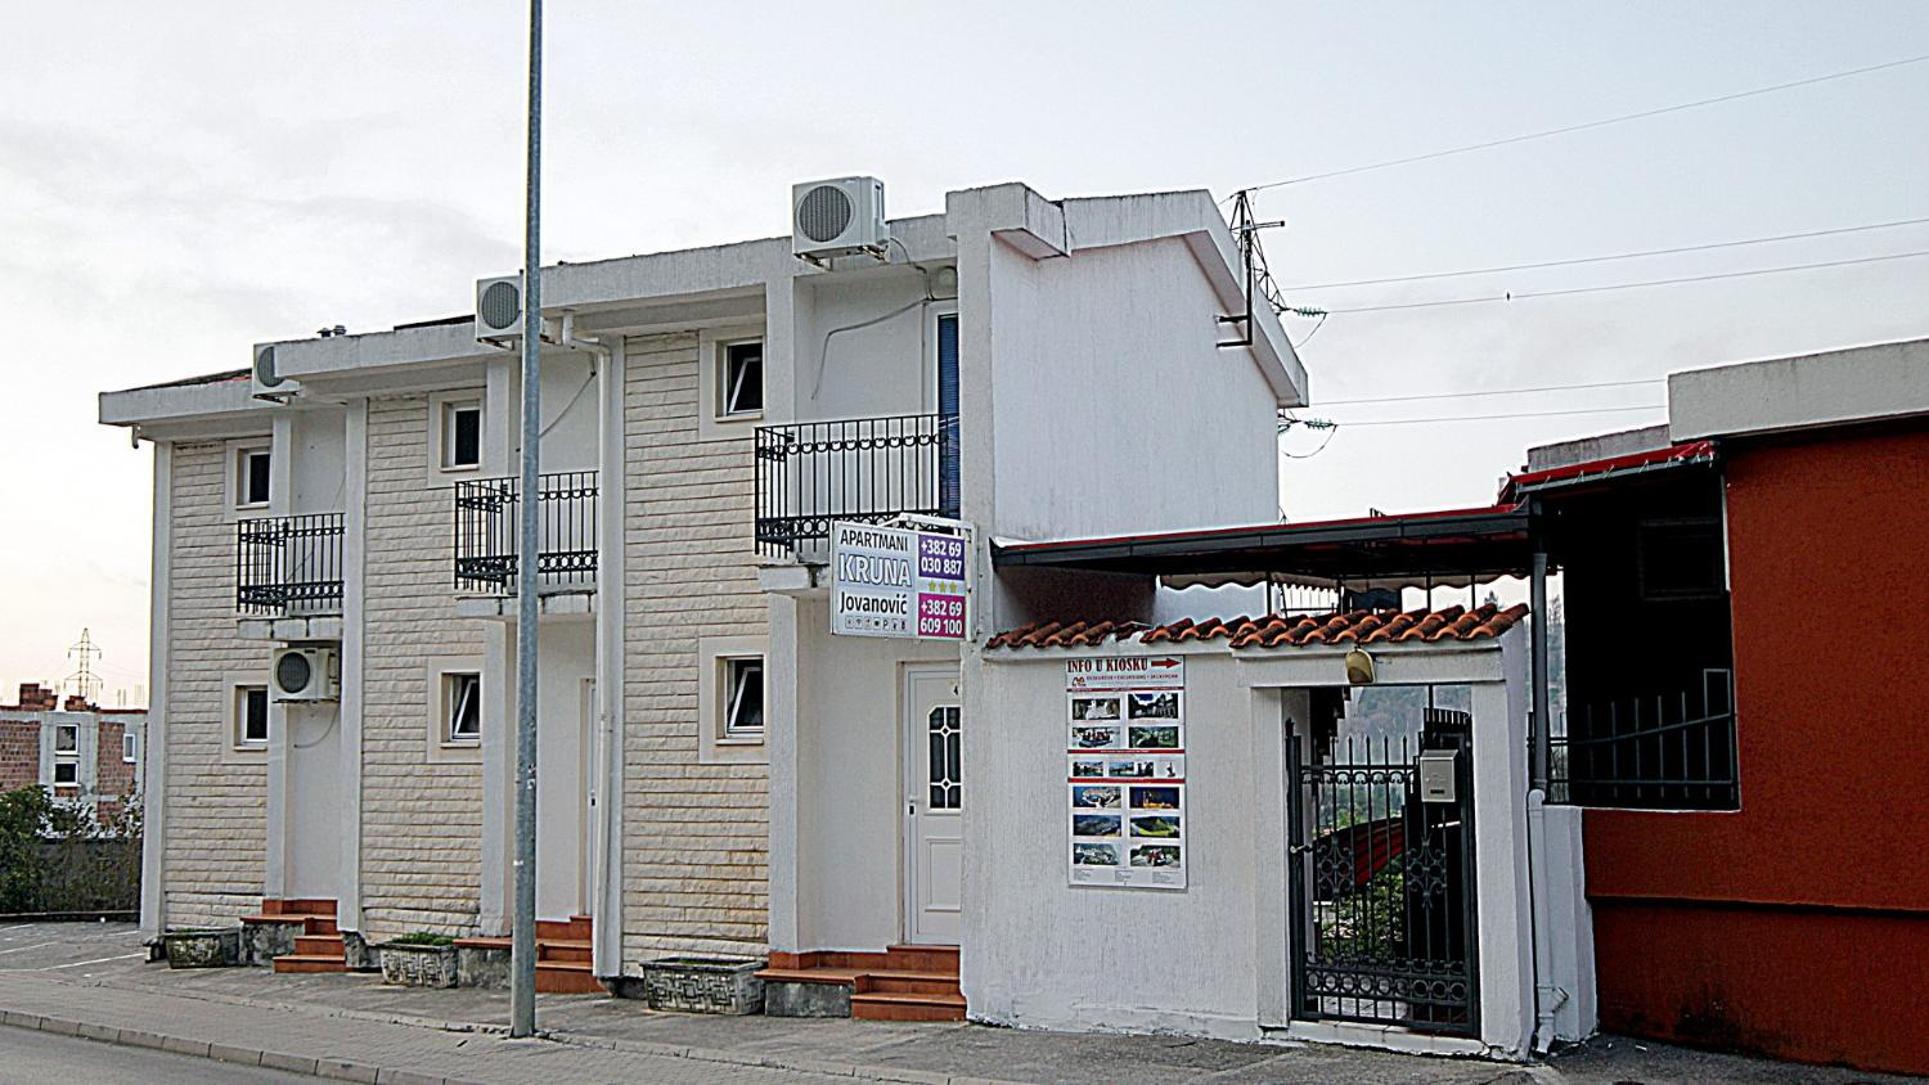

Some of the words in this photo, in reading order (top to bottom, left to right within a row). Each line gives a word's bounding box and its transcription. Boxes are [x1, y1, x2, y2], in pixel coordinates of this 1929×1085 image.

[840, 529, 908, 552] APARTMANI
[921, 539, 946, 555] +382
[949, 541, 962, 557] 69
[839, 553, 912, 587] KRUNA
[921, 556, 942, 573] 030
[943, 559, 962, 575] 887
[840, 591, 908, 615] Jovanović
[921, 600, 947, 615] +382
[949, 601, 962, 617] 69
[920, 618, 941, 633] 609
[943, 619, 963, 635] 100
[1067, 659, 1092, 673] INFO
[1096, 659, 1103, 672] U
[1106, 657, 1148, 672] KIOSKU
